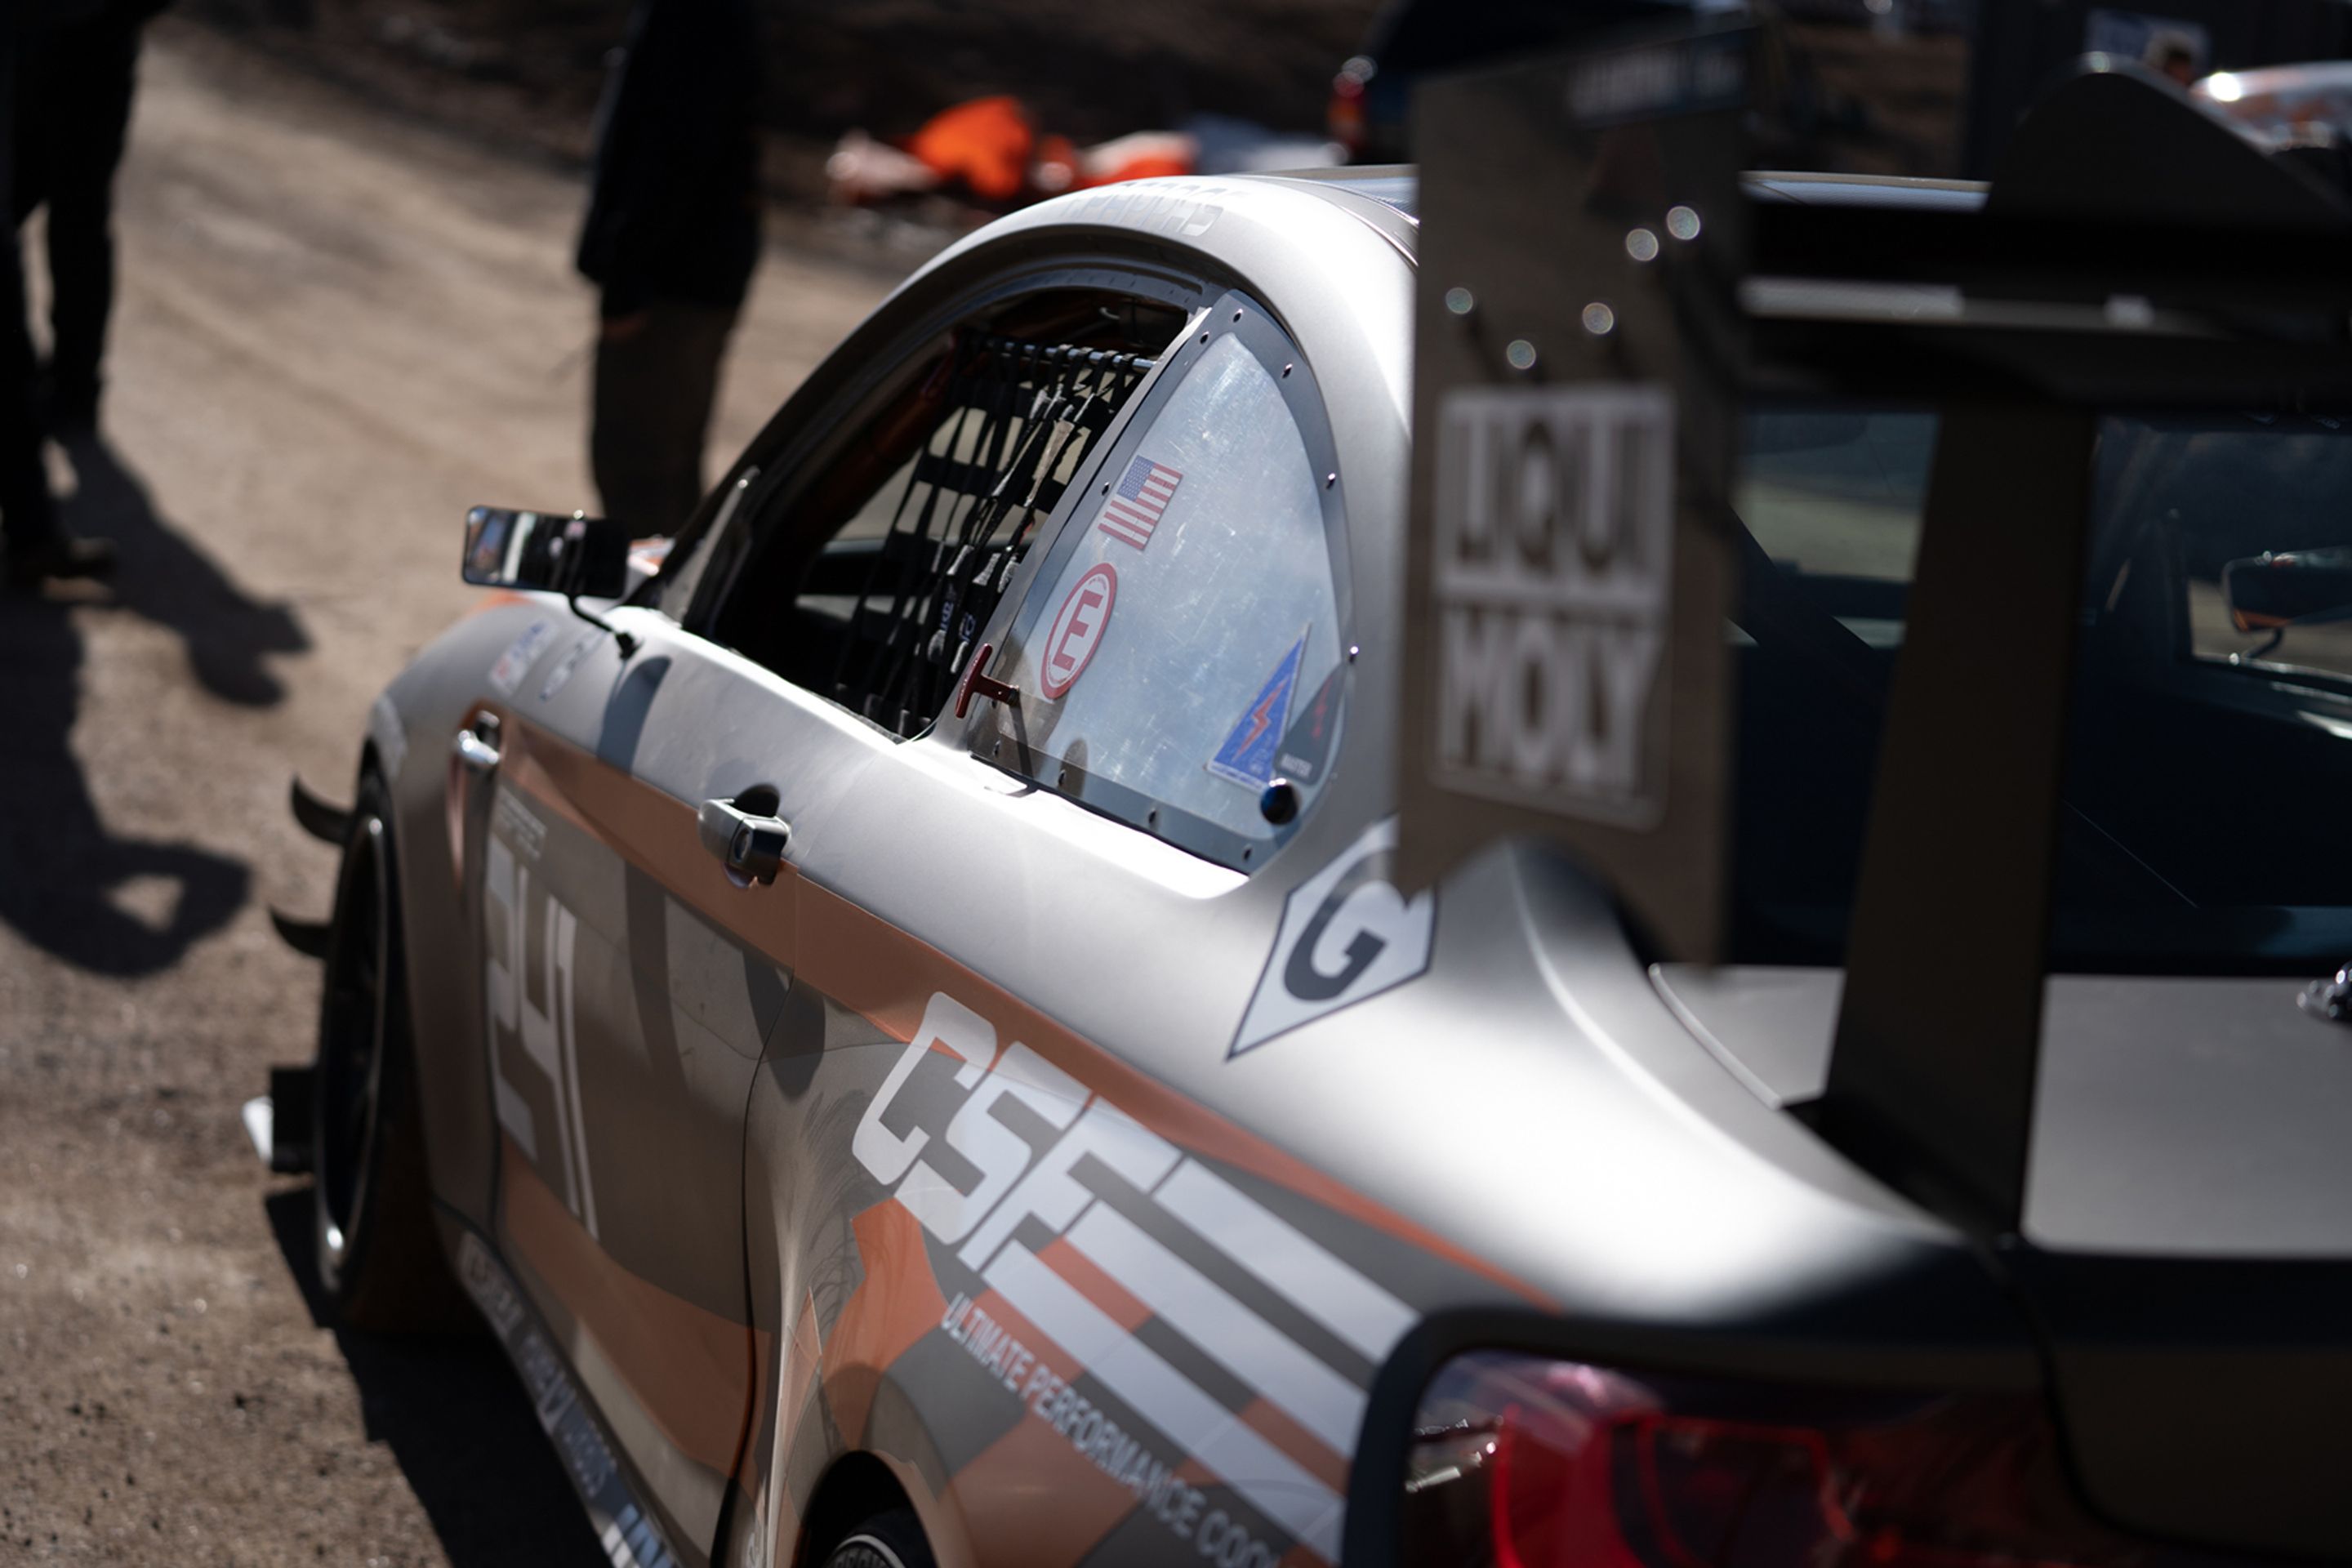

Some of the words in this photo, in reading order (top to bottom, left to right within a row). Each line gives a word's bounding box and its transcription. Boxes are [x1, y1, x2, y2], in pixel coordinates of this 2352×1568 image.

[1437, 606, 1666, 792] MOLY
[853, 991, 1182, 1272] CSF
[941, 1292, 1036, 1392] ULTIMATE
[1020, 1366, 1207, 1539] PERFORMANCE
